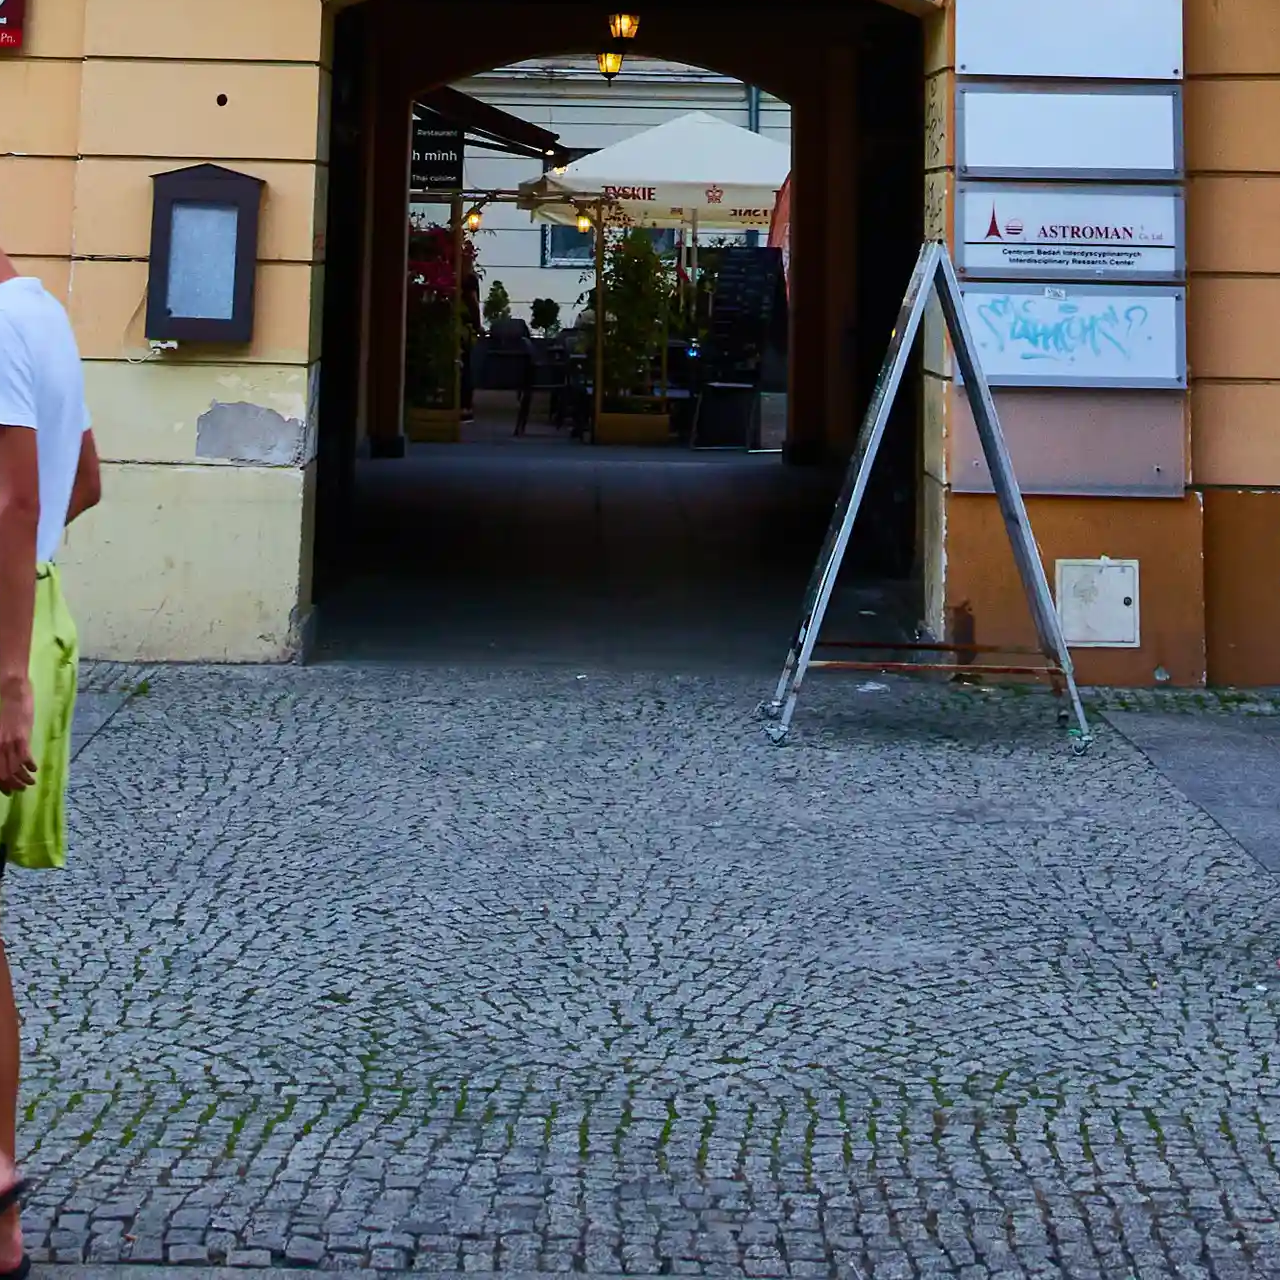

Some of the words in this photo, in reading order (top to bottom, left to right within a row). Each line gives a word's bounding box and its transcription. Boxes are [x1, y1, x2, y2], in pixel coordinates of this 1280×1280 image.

[0, 32, 16, 43] Pn.
[601, 185, 656, 201] TYSKIE
[1037, 225, 1133, 240] ASTROMAN
[1002, 248, 1035, 256] Centrum
[1109, 259, 1136, 267] Center
